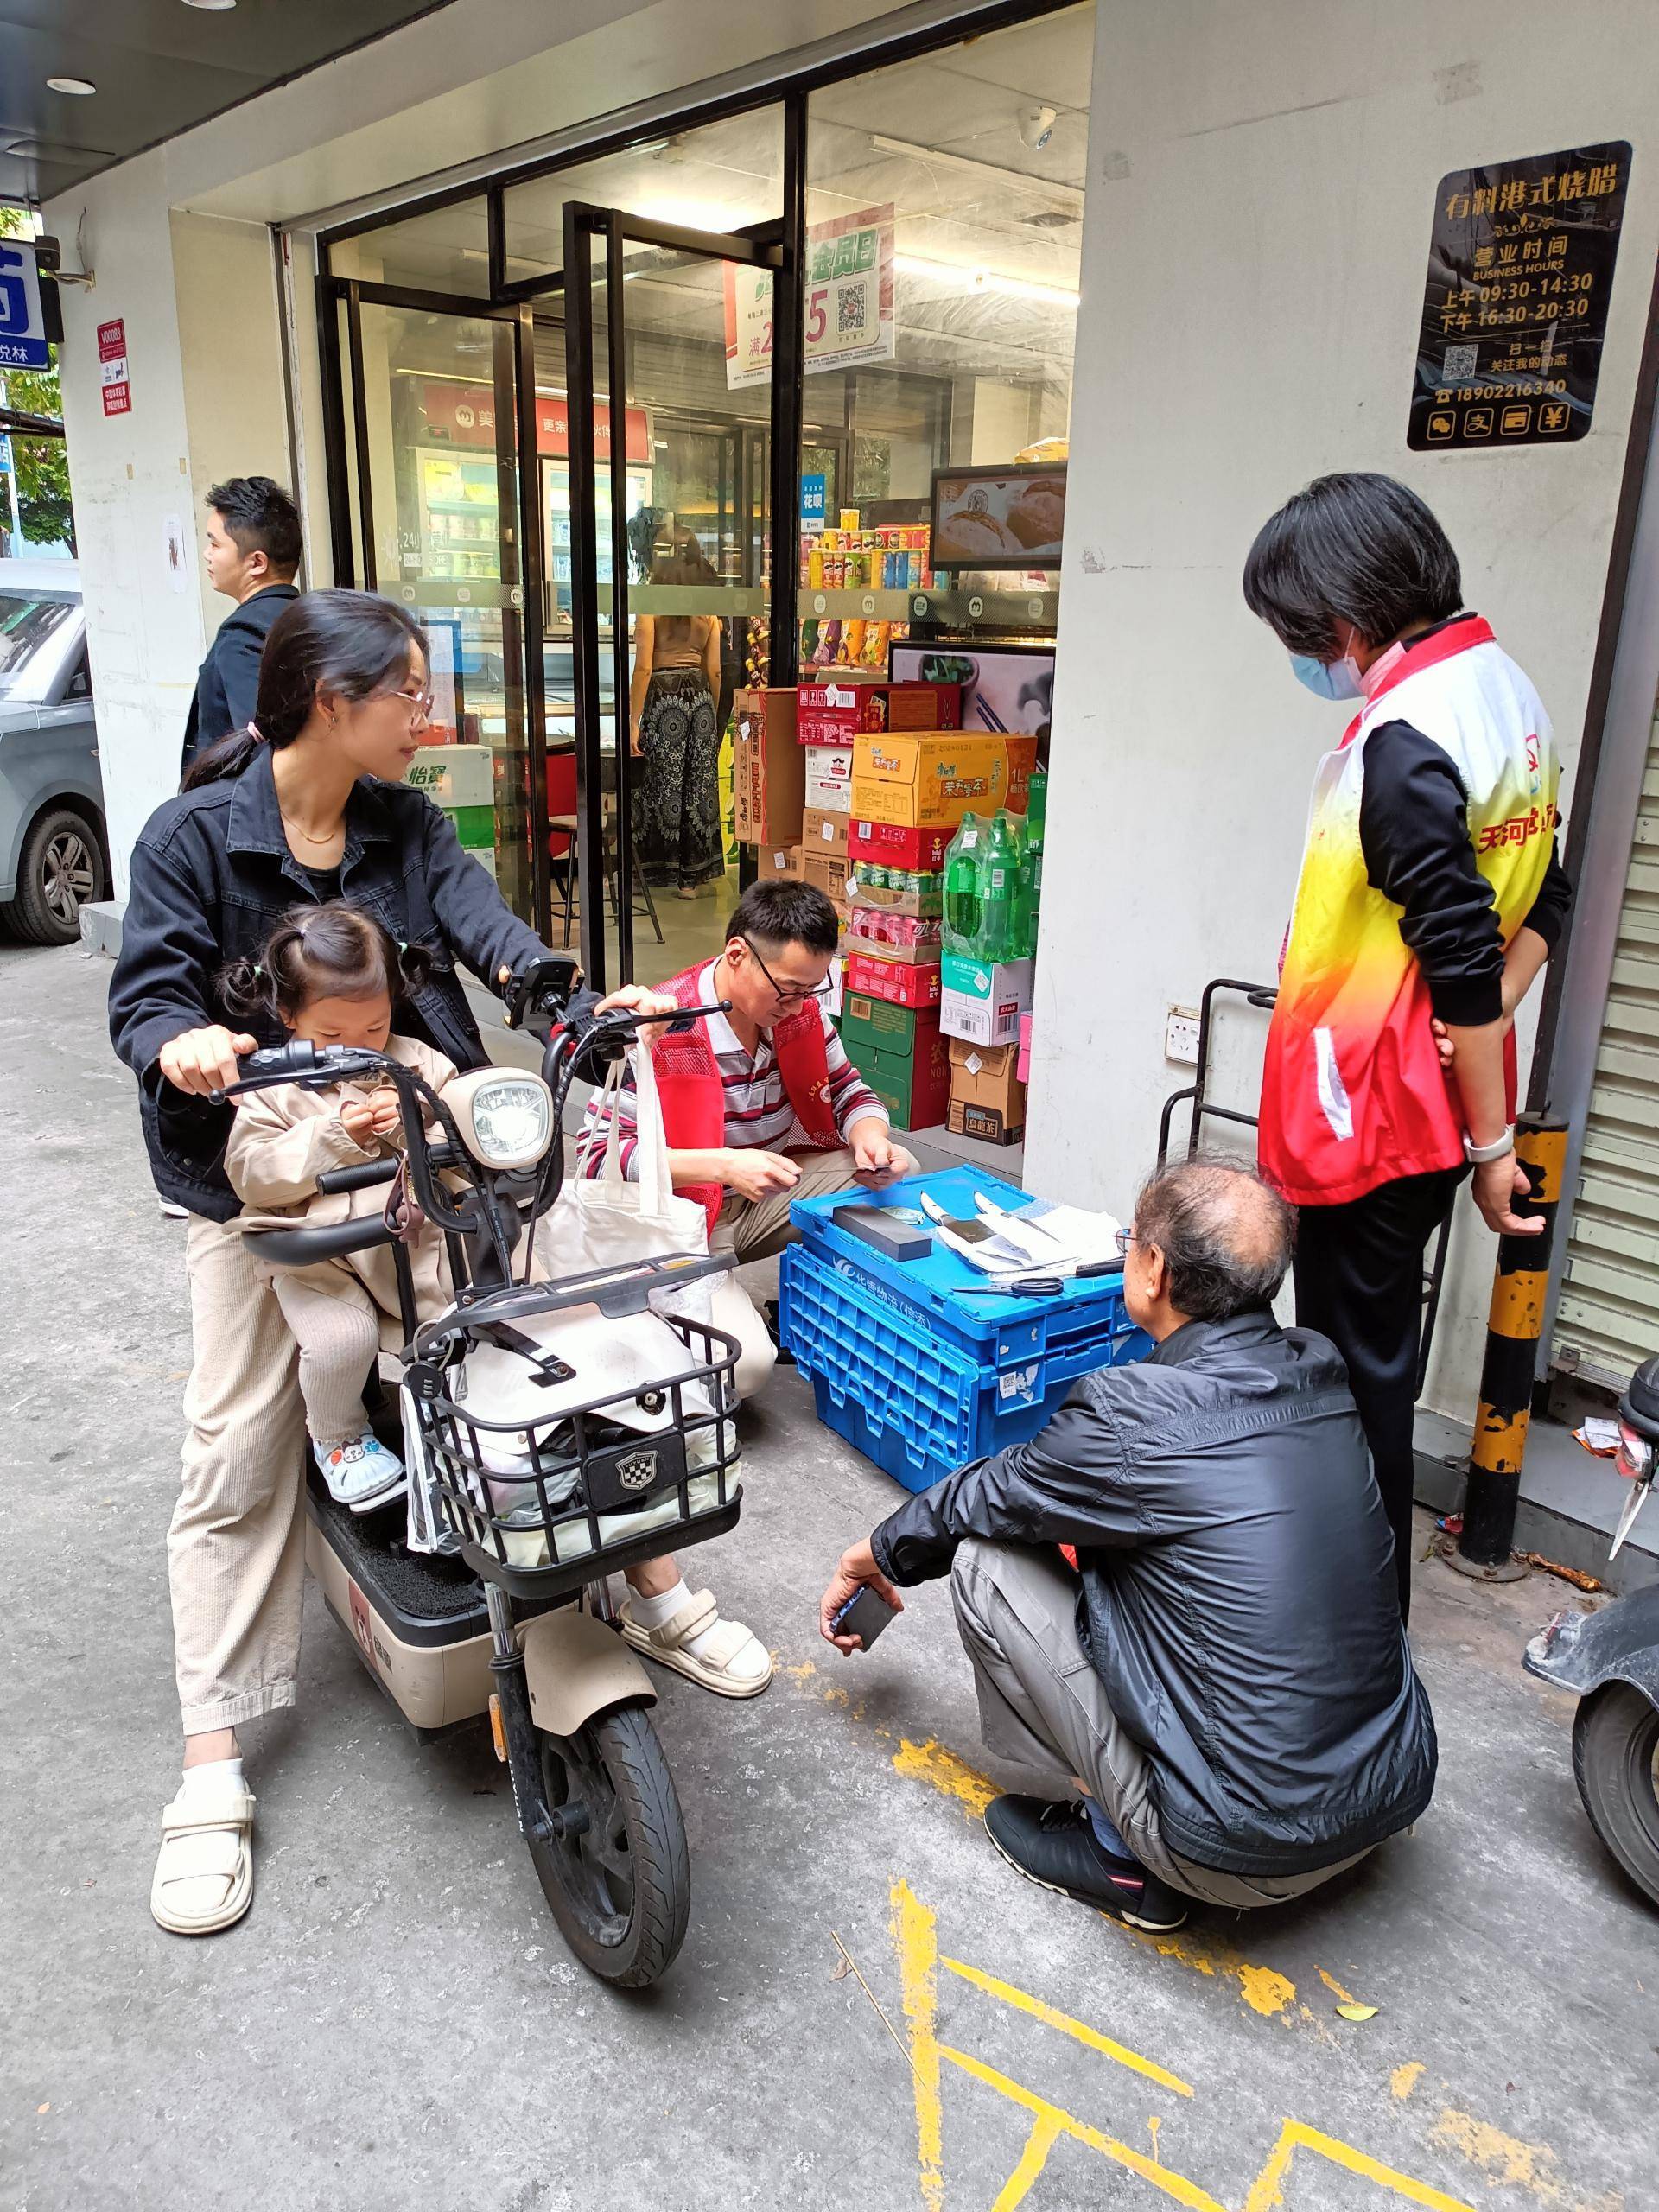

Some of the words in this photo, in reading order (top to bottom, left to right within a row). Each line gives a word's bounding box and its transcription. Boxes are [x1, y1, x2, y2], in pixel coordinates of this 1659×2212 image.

[1445, 163, 1618, 221] 有料港式烧腊
[805, 229, 878, 285] 会员日
[1474, 234, 1569, 268] 营业时间
[1472, 264, 1523, 281] BUSINESS
[1525, 259, 1565, 273] HOURS
[1441, 288, 1475, 311] 上午
[1479, 272, 1593, 303] 09:30-14:30
[1440, 312, 1472, 334] 下午
[1478, 298, 1589, 327] 16:30-20:30
[1509, 340, 1554, 356] 扫一扫
[1490, 354, 1568, 373] 关注我的动态
[1456, 379, 1567, 403] 18902216340
[943, 779, 986, 797] 茉莉蜜茶
[625, 1457, 650, 1468] LUYUAN
